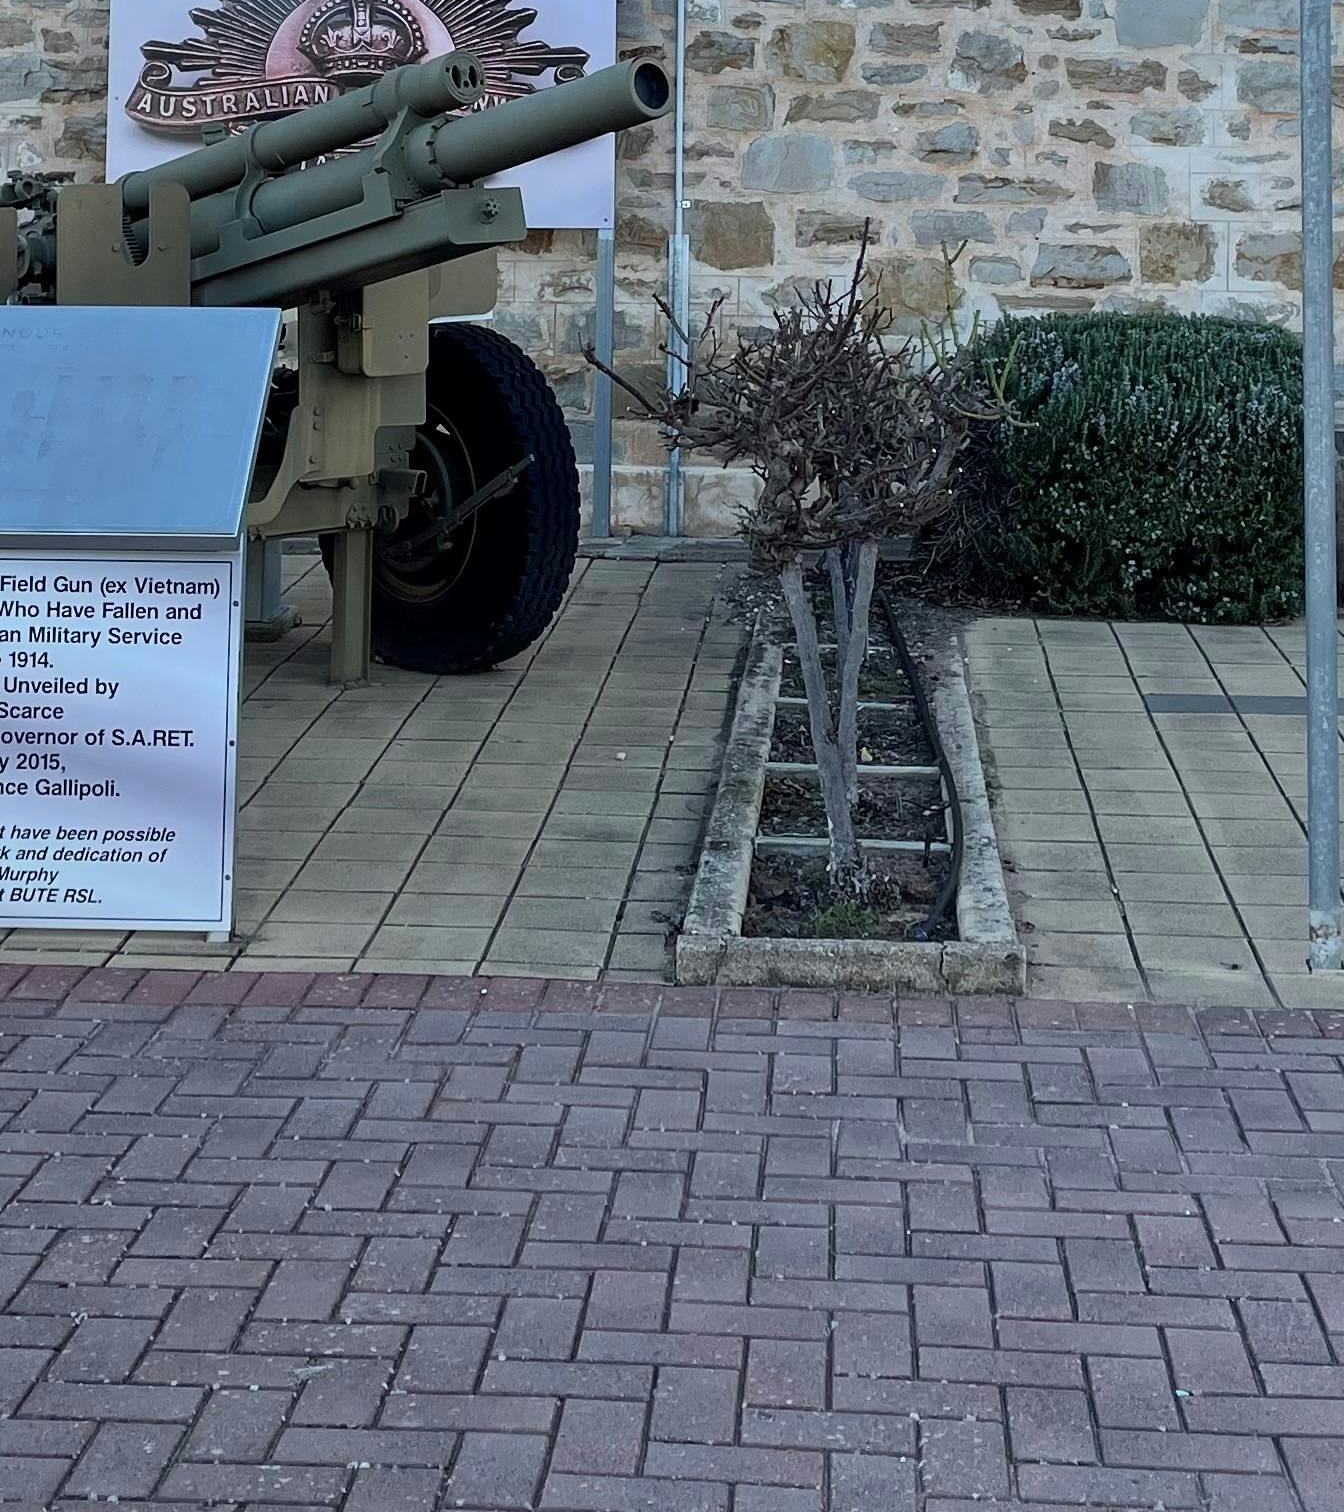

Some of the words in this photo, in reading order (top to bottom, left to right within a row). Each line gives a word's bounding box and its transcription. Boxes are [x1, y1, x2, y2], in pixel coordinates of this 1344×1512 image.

[136, 84, 329, 119] AUSTRALIAN
[0, 575, 46, 592] Field
[53, 576, 92, 593] Gun
[100, 577, 127, 598] (ex
[134, 577, 220, 600] Vietnam)
[47, 601, 95, 619] Have
[102, 602, 158, 619] Fallen
[165, 603, 202, 620] and
[29, 626, 101, 648] Military
[108, 627, 182, 645] Service
[8, 651, 54, 668] 1914.
[4, 676, 88, 694] Unveiled
[95, 678, 120, 699] by
[85, 729, 105, 746] of
[112, 729, 194, 747] S.A.RET.
[16, 753, 66, 774] 2015,
[35, 778, 120, 801] Gallipoli.
[10, 824, 51, 840] have
[56, 825, 98, 841] been
[101, 827, 176, 845] possible
[15, 846, 49, 861] and
[52, 846, 143, 863] dedication
[148, 848, 168, 863] of
[9, 887, 60, 903] BUTE
[63, 888, 102, 904] RSL.
